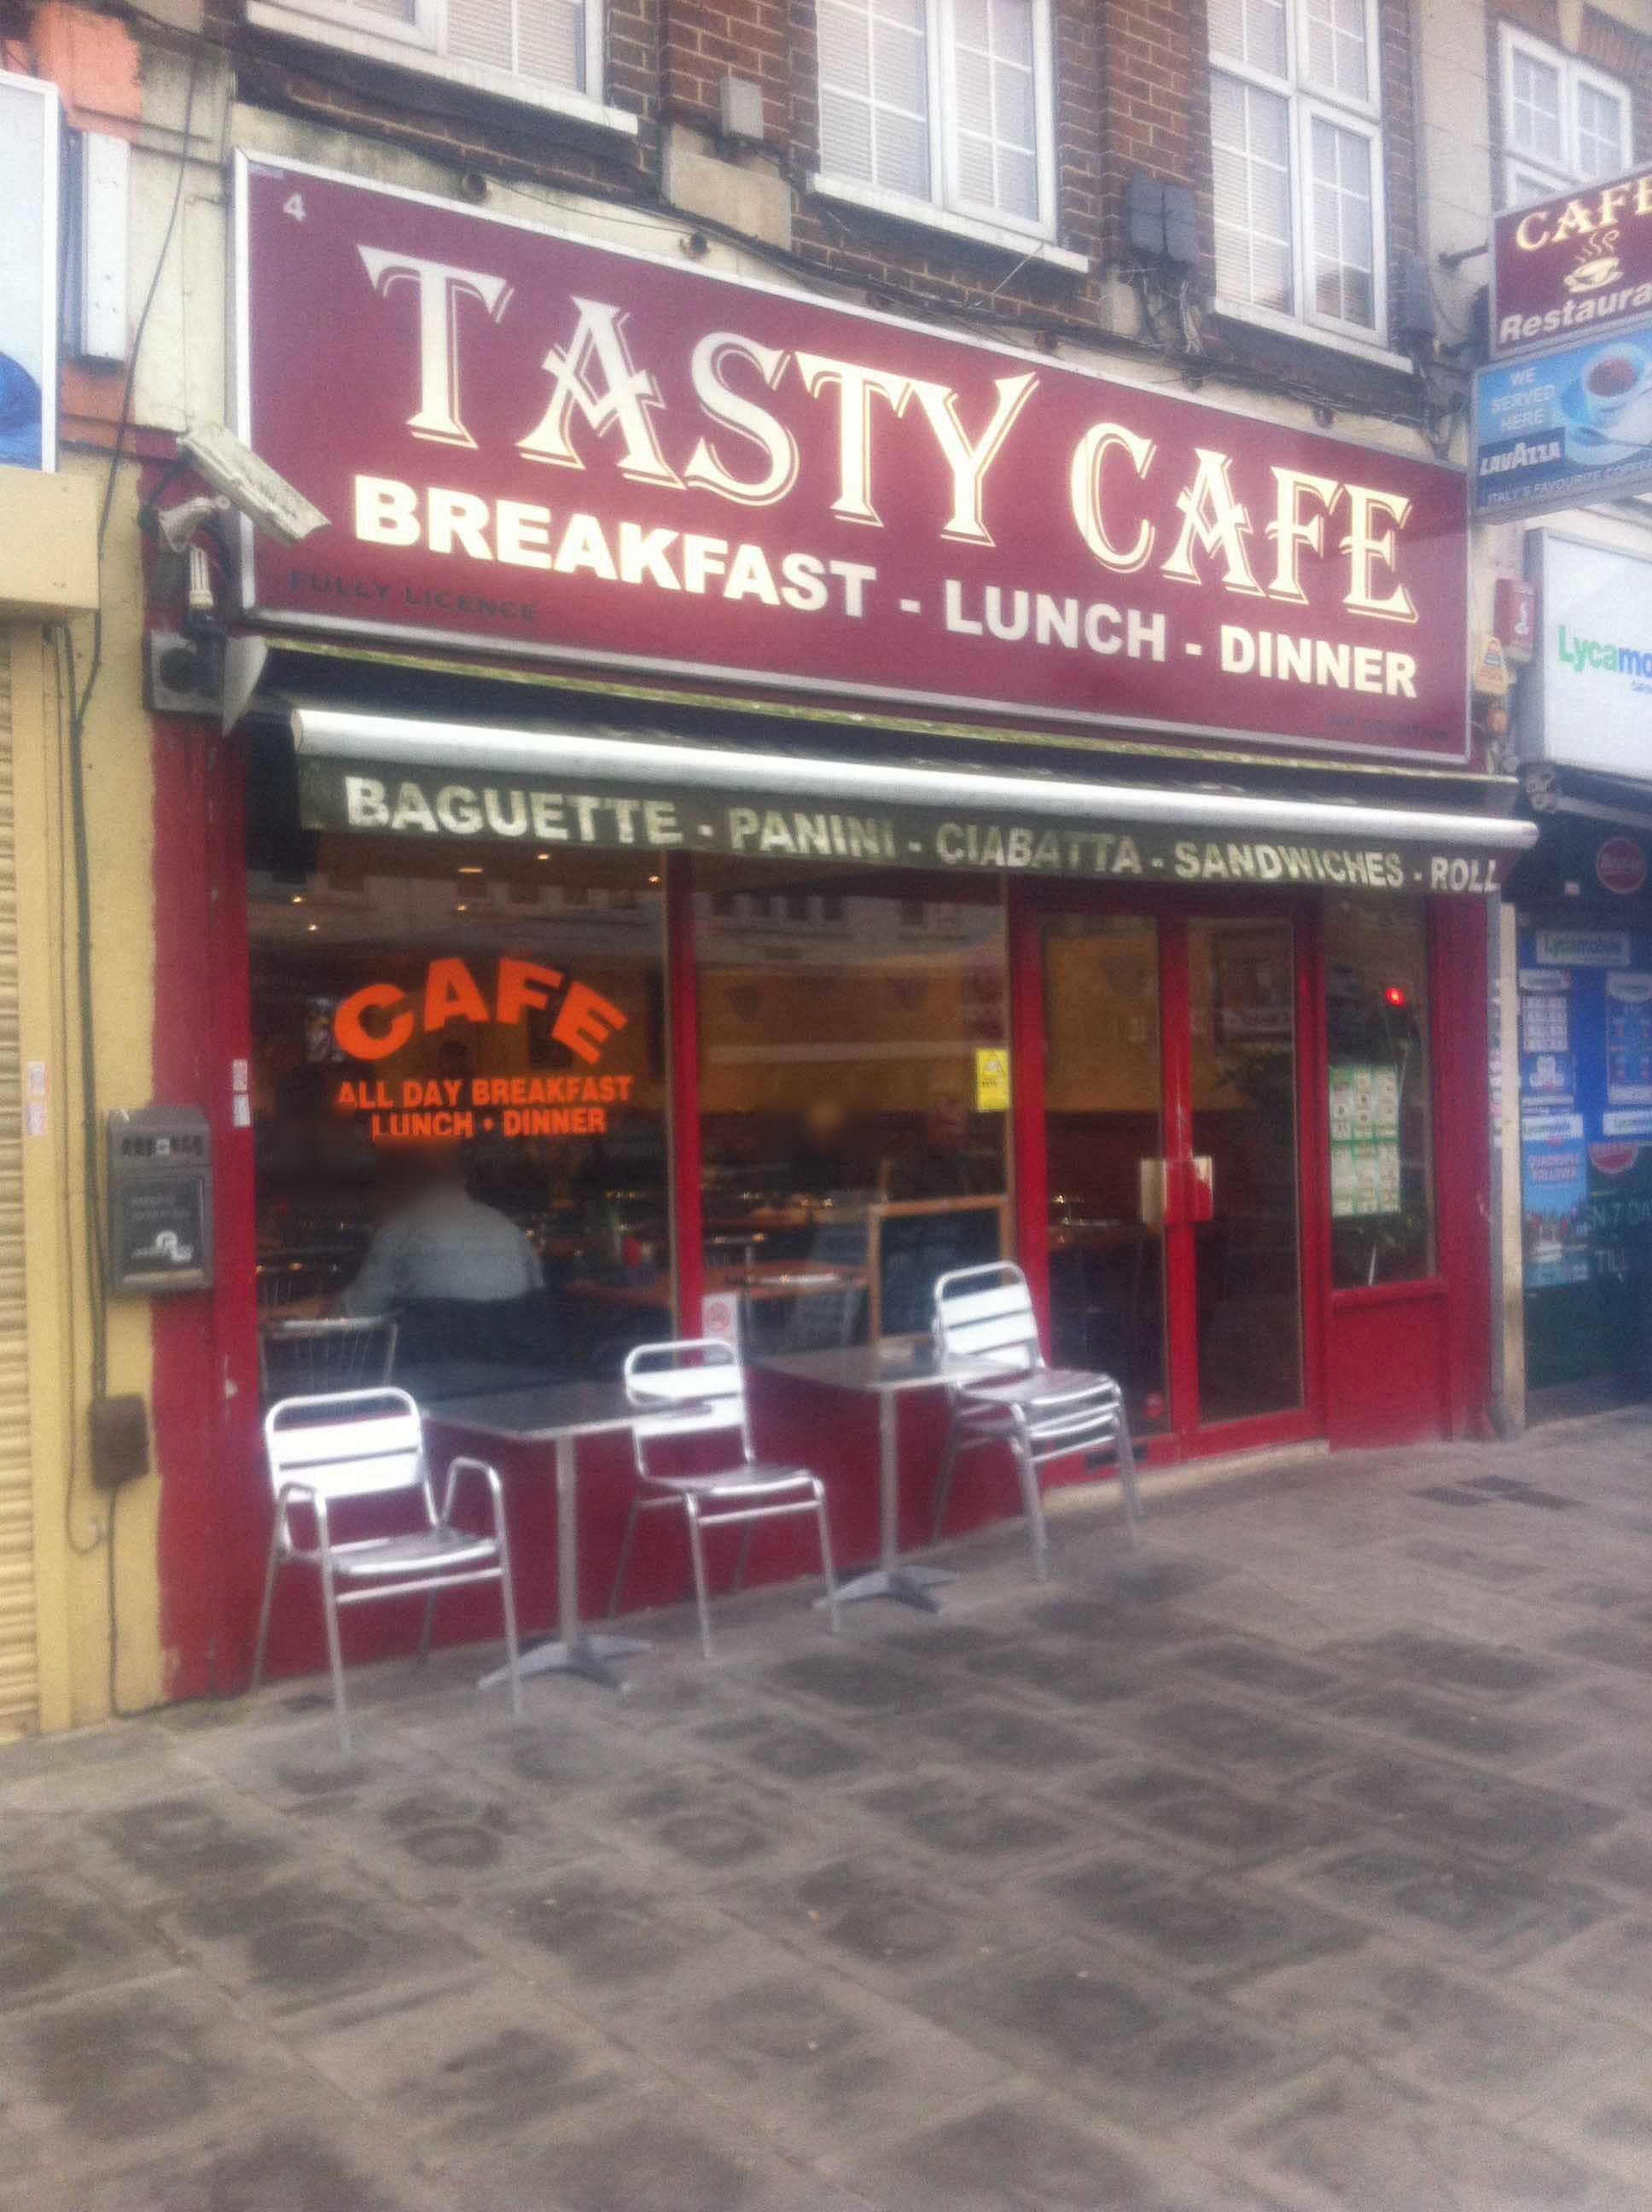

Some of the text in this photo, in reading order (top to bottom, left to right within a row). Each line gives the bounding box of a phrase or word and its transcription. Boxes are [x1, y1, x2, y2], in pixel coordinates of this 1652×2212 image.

[282, 193, 307, 222] 4
[1499, 282, 1652, 343] Restaura
[357, 244, 1419, 624] TASTY CAFE
[289, 569, 538, 621] FULLY LICENCE
[354, 474, 876, 619] BREAKFAST
[944, 579, 1167, 663] LUNCH
[1219, 624, 1417, 699] DINNER
[344, 776, 683, 845] BAGUETTE
[725, 806, 896, 859] PANINI
[936, 822, 1143, 875] CIABATTA
[1174, 841, 1405, 888] SANDWICHES
[1430, 857, 1503, 894] ROLL
[334, 957, 629, 1065] CAFE
[338, 1074, 634, 1109] ALL DAY BREAKFAST
[371, 1110, 474, 1141] LUNCH
[503, 1108, 608, 1138] DINNER
